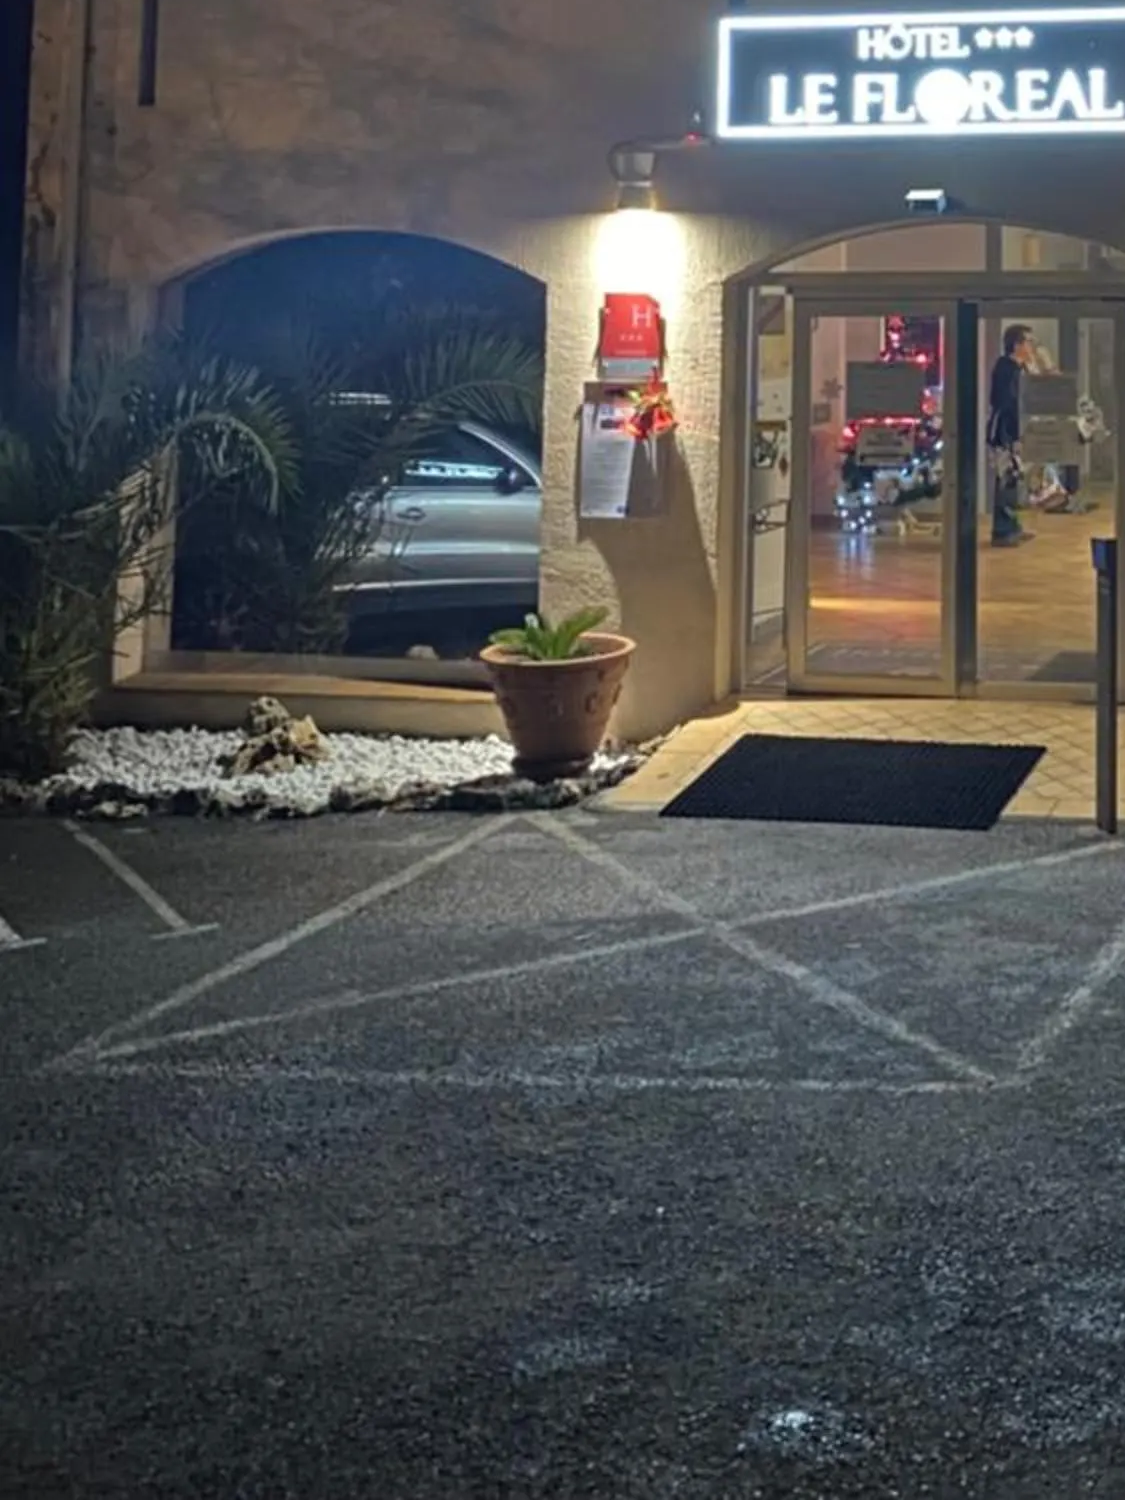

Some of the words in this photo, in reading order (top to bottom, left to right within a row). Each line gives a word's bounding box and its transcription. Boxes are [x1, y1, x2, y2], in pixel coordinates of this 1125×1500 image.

[768, 73, 838, 125] LE
[852, 67, 1125, 126] FLOREAL
[631, 303, 653, 328] H
